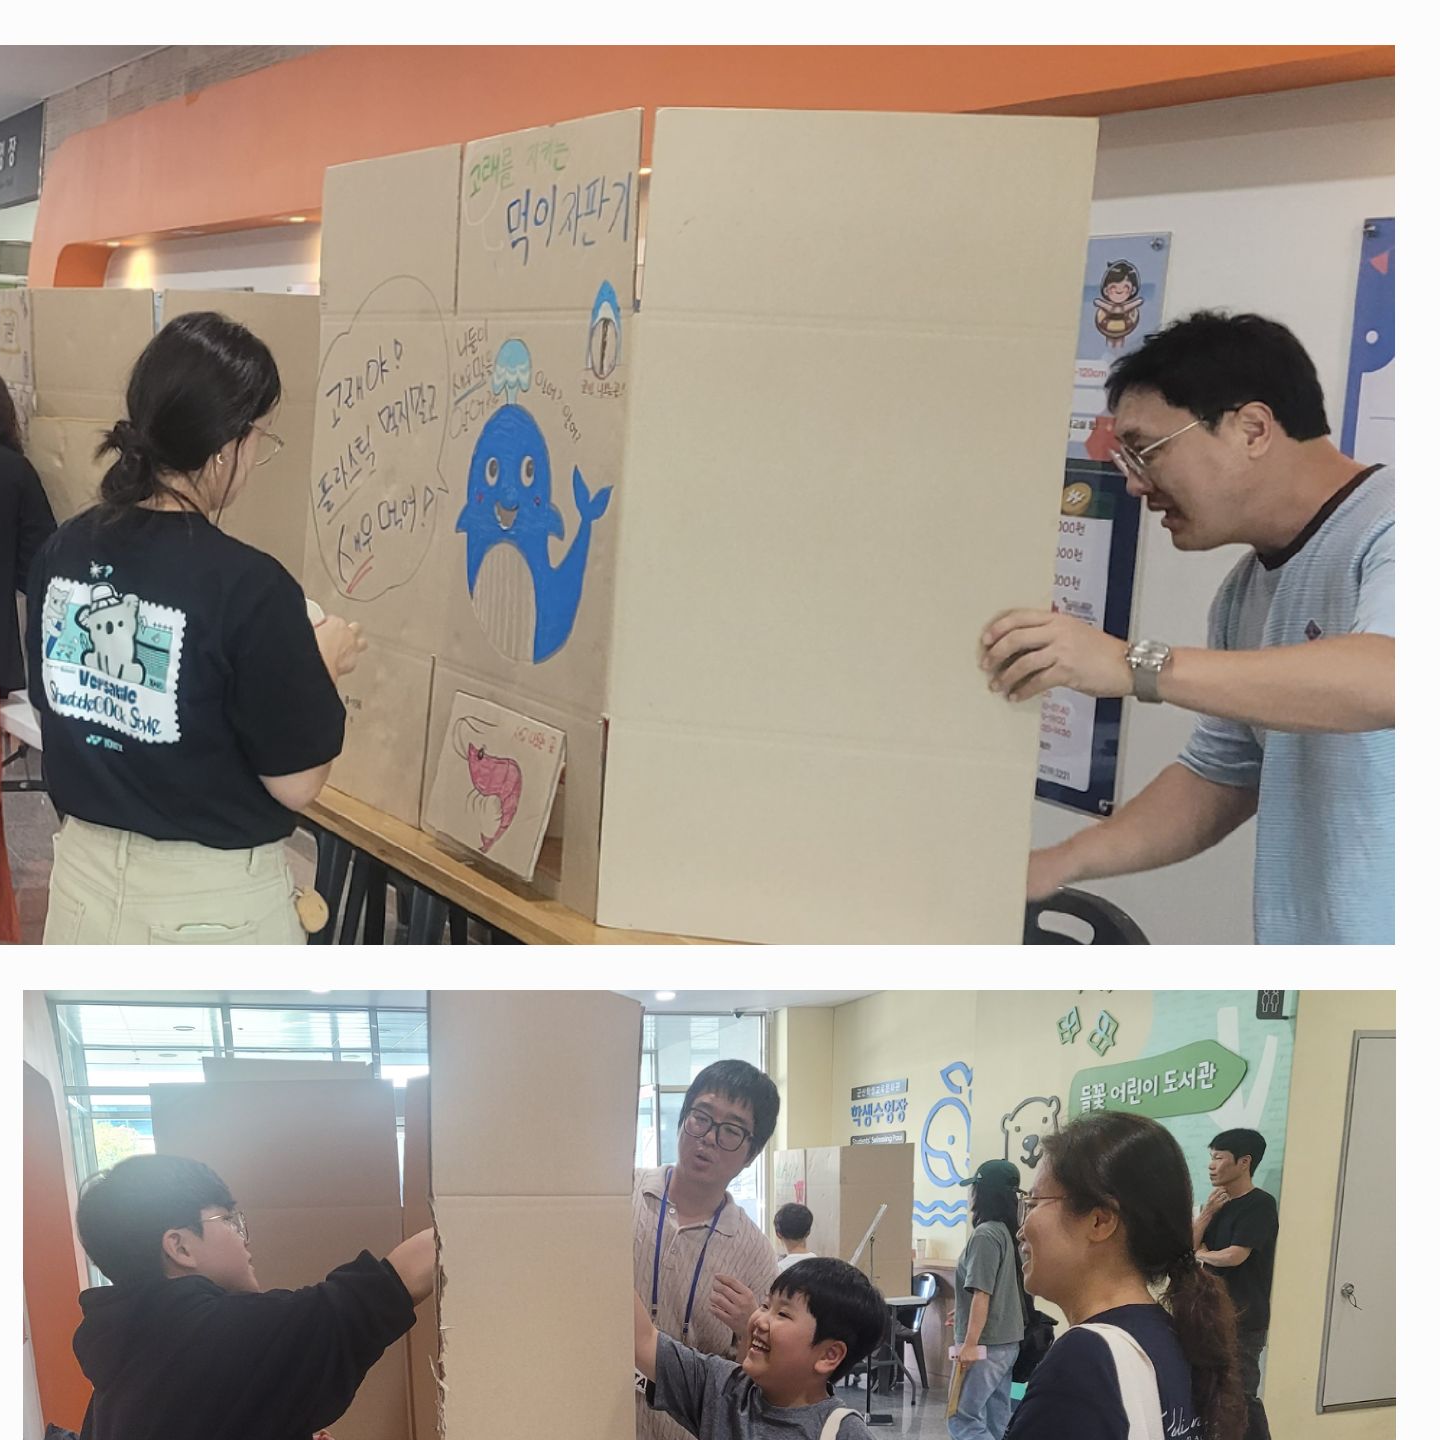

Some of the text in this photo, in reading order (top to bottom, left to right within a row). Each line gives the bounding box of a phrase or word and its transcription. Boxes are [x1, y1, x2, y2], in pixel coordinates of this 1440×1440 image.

[317, 424, 376, 514] 플라스틱
[851, 1098, 908, 1127] 학생수영장
[1080, 1061, 1216, 1113] 들꽃 어린이 도서관
